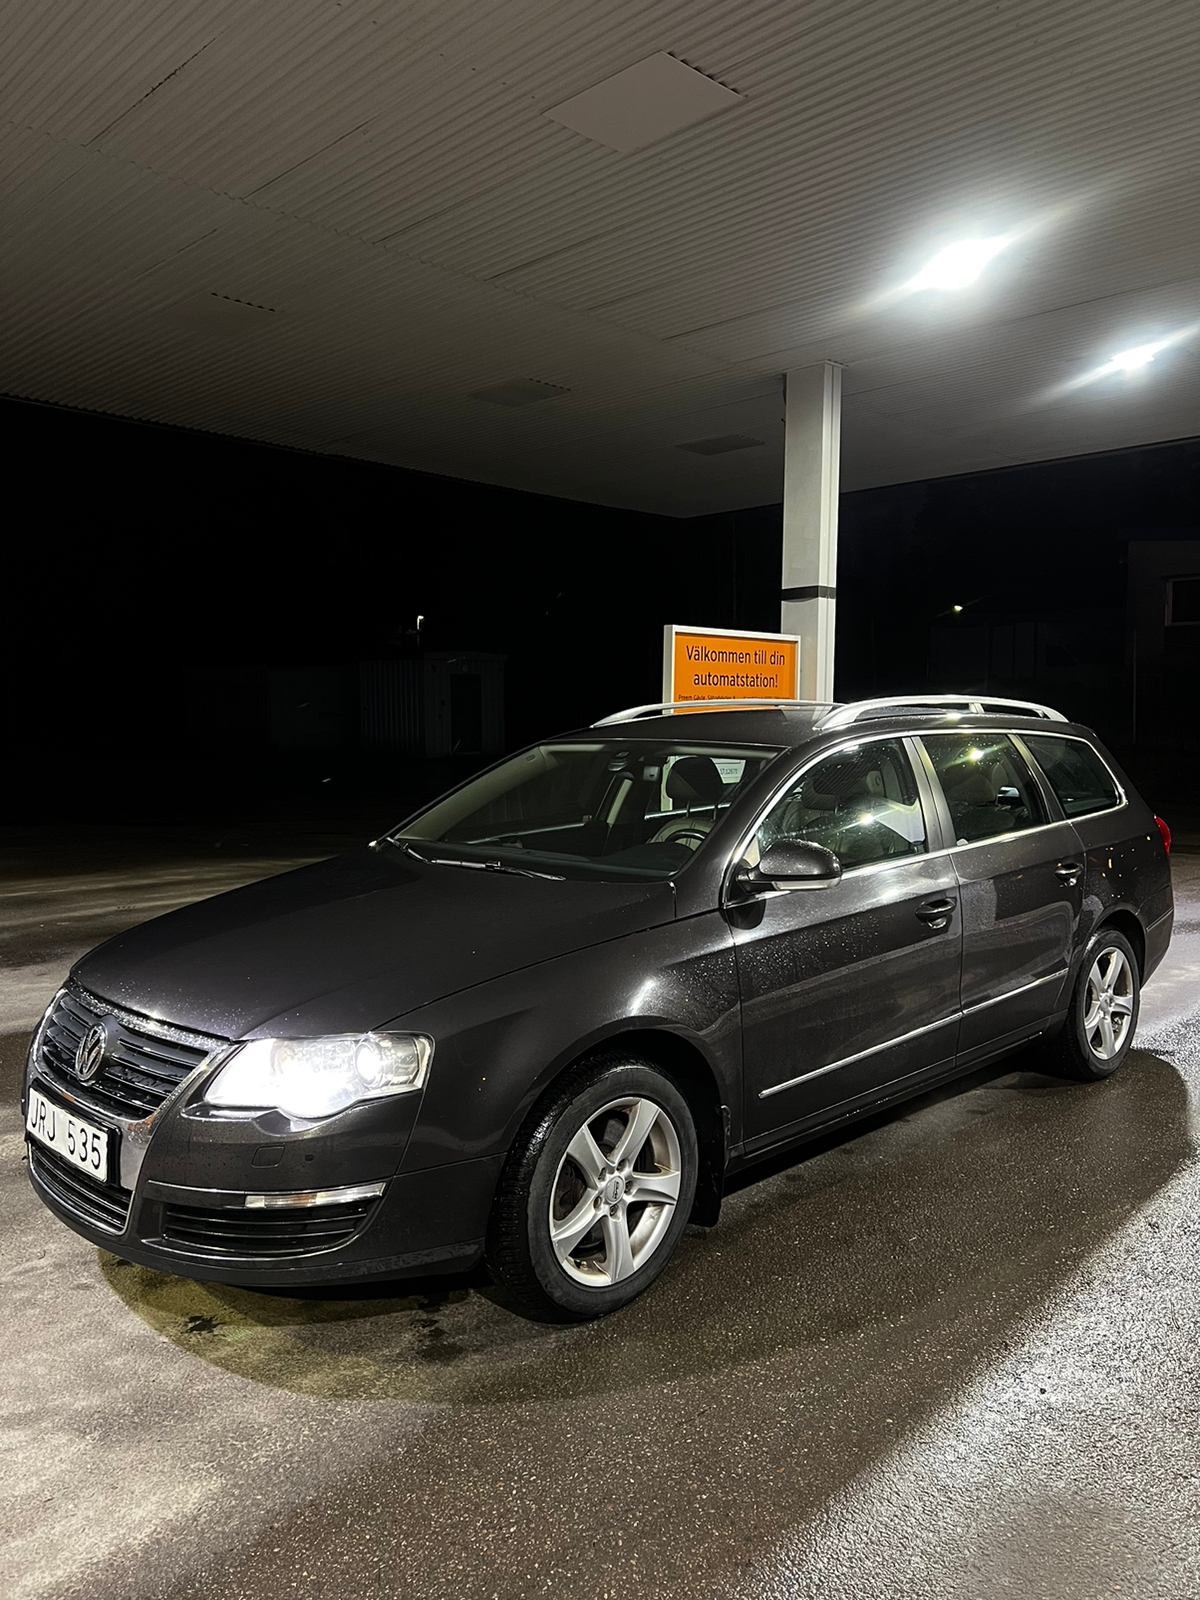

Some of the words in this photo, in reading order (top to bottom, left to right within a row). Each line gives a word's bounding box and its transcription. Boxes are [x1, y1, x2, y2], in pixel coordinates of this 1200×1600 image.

[686, 645, 751, 664] Välkommen
[753, 649, 767, 665] till
[769, 651, 786, 666] din
[693, 672, 779, 688] automatstation!
[30, 1098, 56, 1142] JRJ
[68, 1119, 101, 1170] 535
